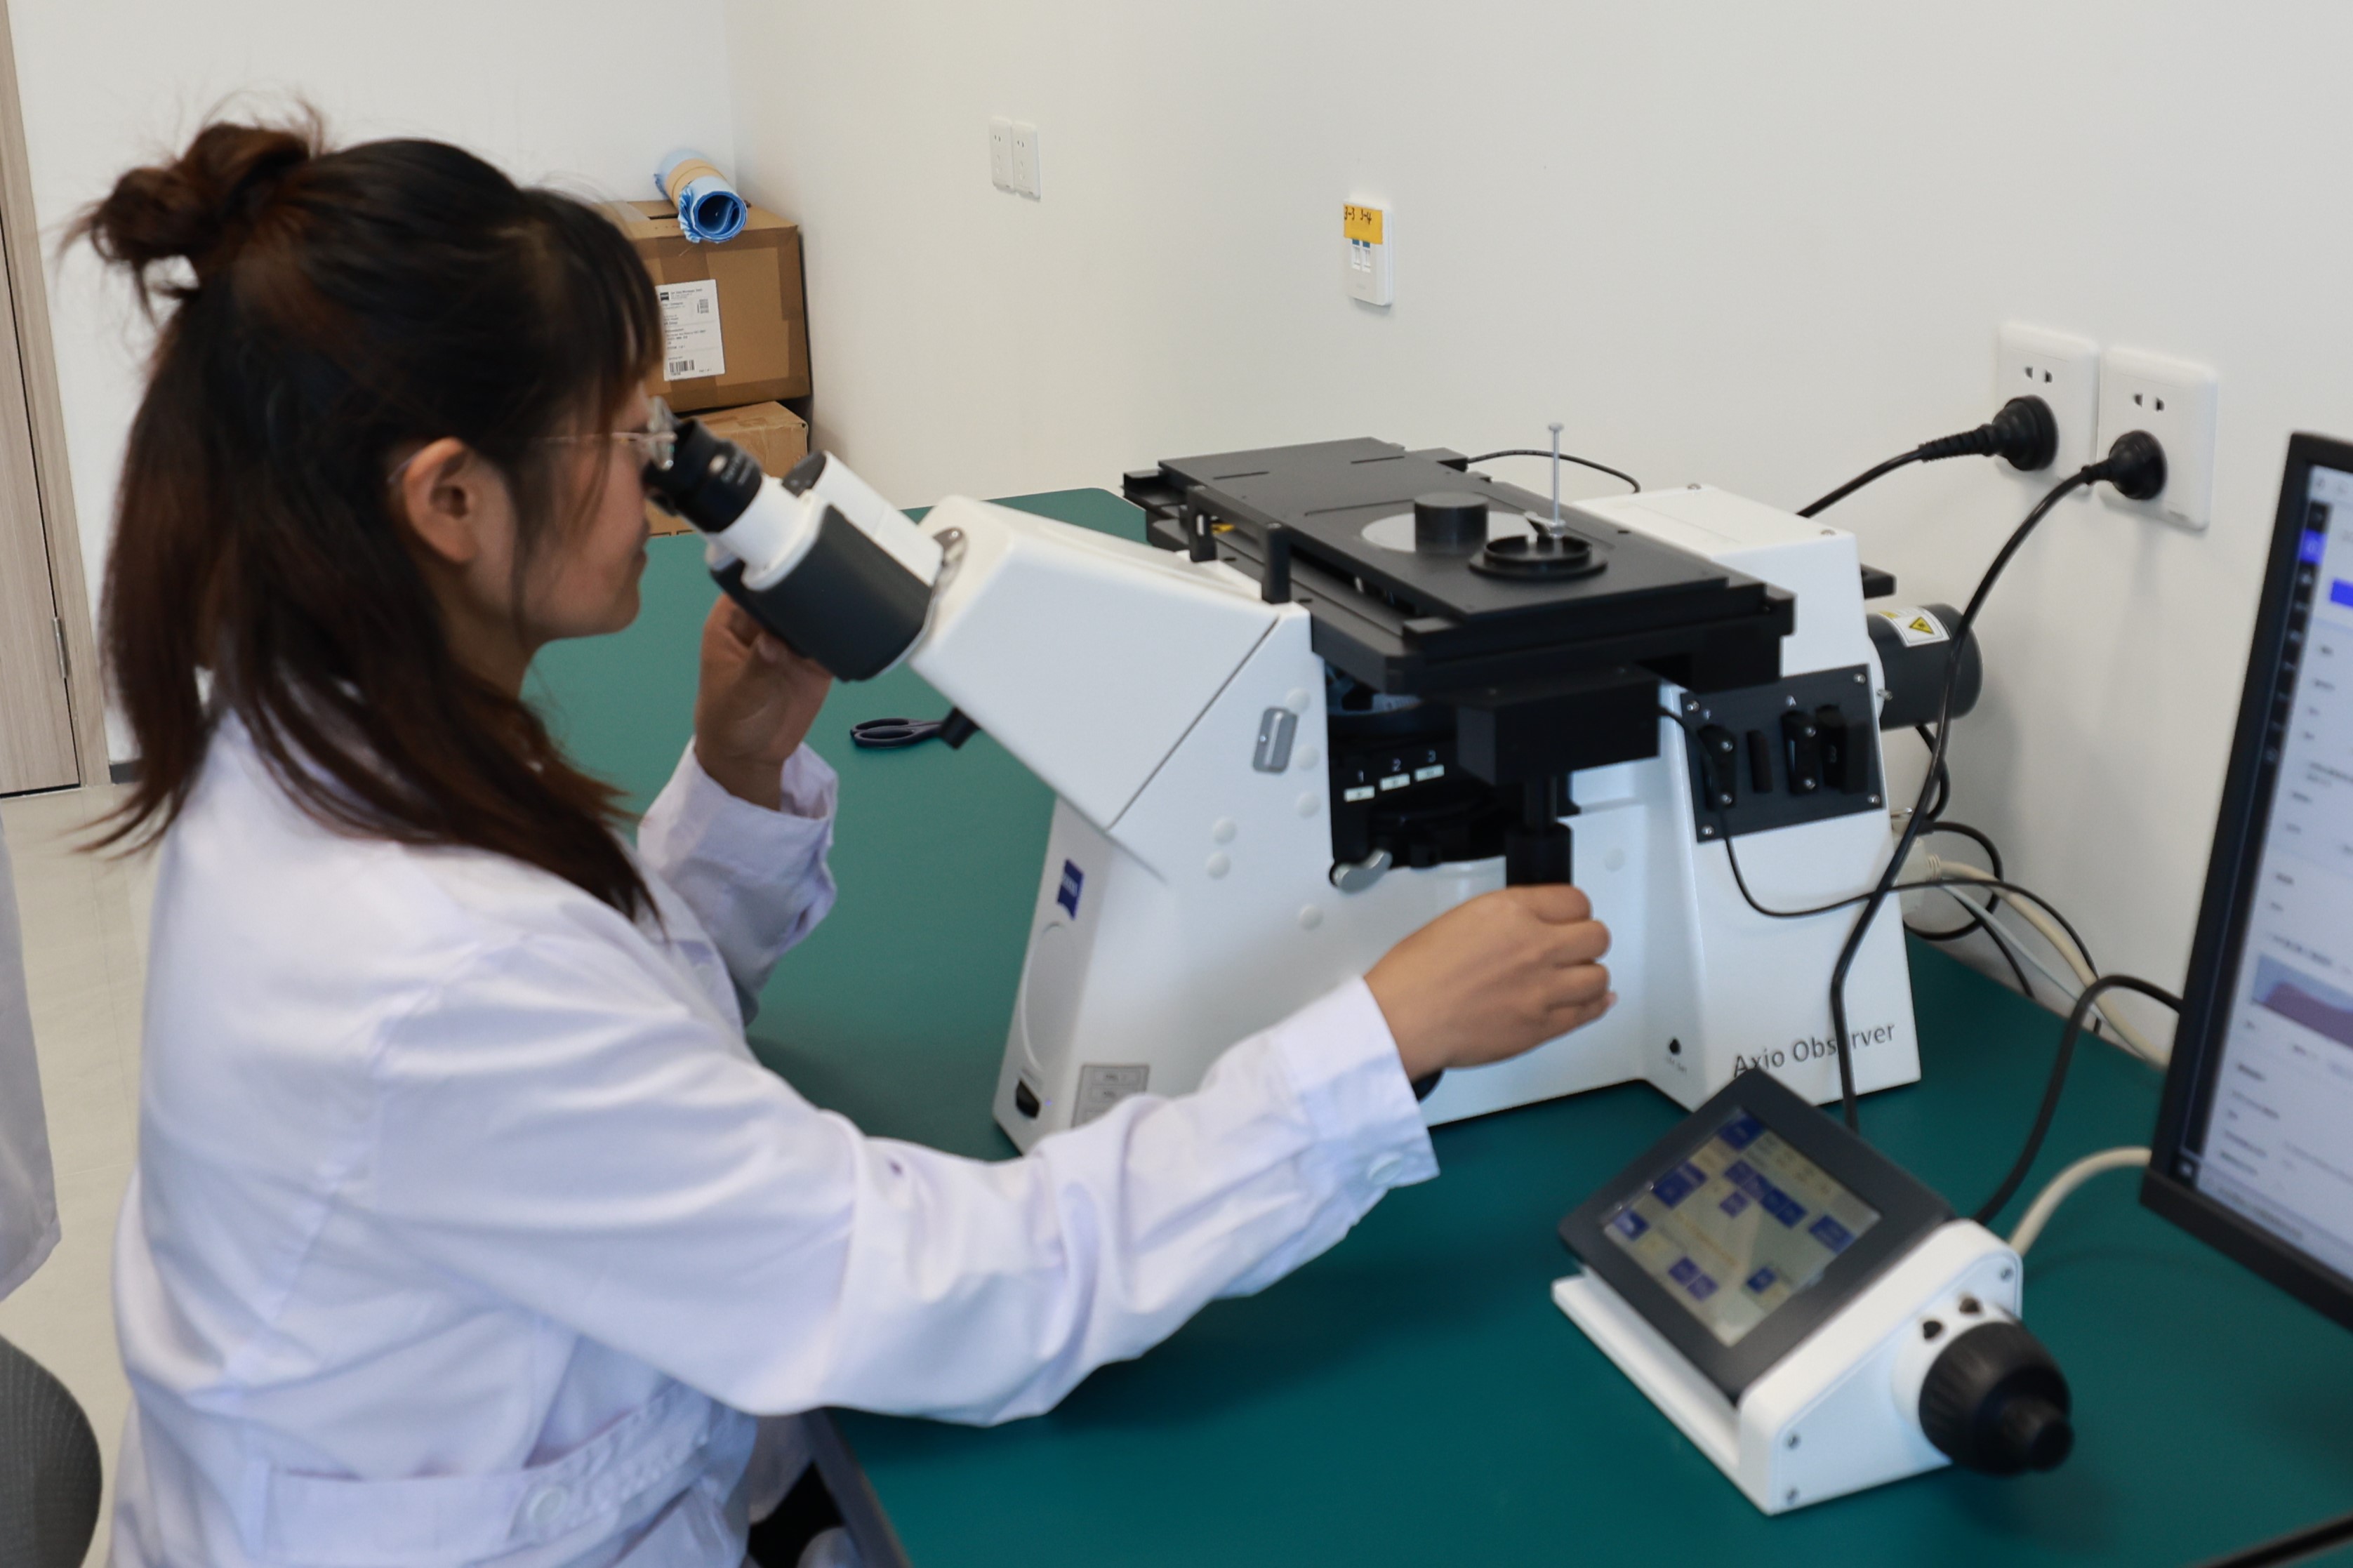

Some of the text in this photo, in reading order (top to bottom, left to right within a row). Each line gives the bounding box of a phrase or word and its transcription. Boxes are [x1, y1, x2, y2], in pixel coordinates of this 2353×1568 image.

[1391, 758, 1402, 772] 2
[1426, 749, 1437, 764] 3
[1733, 1023, 1895, 1079] Axio Obsrver
